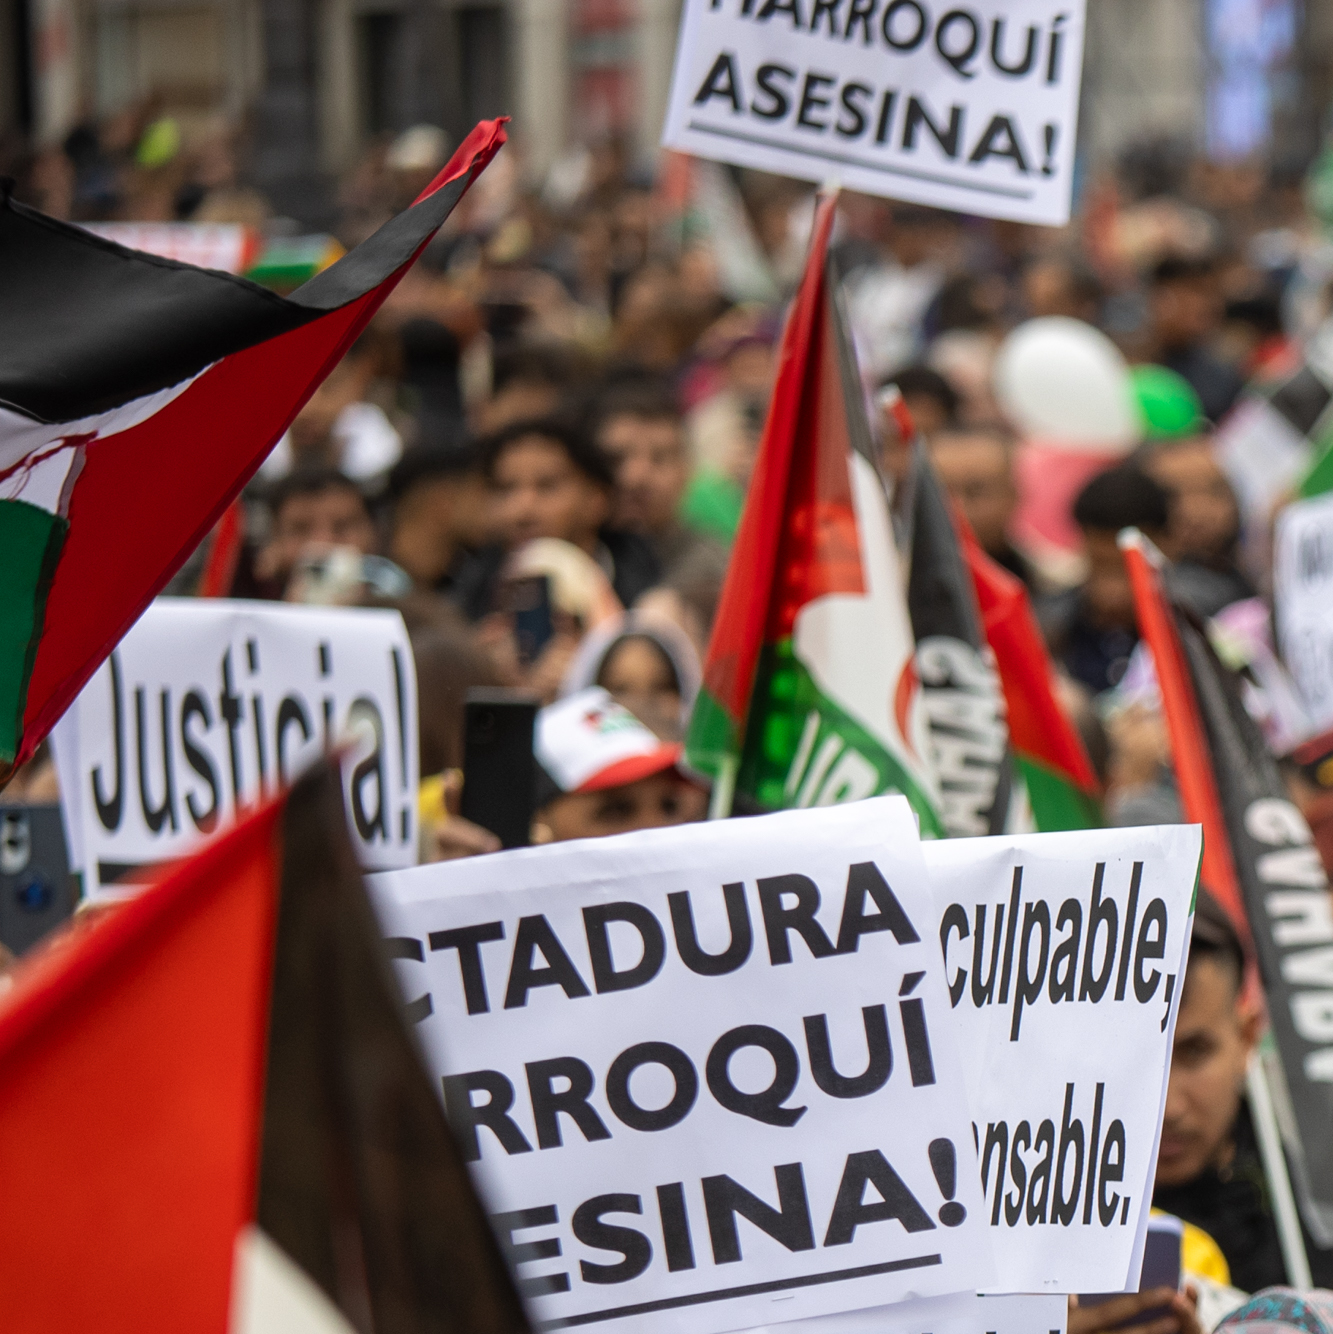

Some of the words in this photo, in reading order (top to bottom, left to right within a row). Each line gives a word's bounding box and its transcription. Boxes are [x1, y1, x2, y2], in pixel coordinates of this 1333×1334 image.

[692, 50, 1058, 176] ASESINA!
[940, 861, 1176, 1041] culpable,
[971, 1081, 1132, 1228] nsable.
